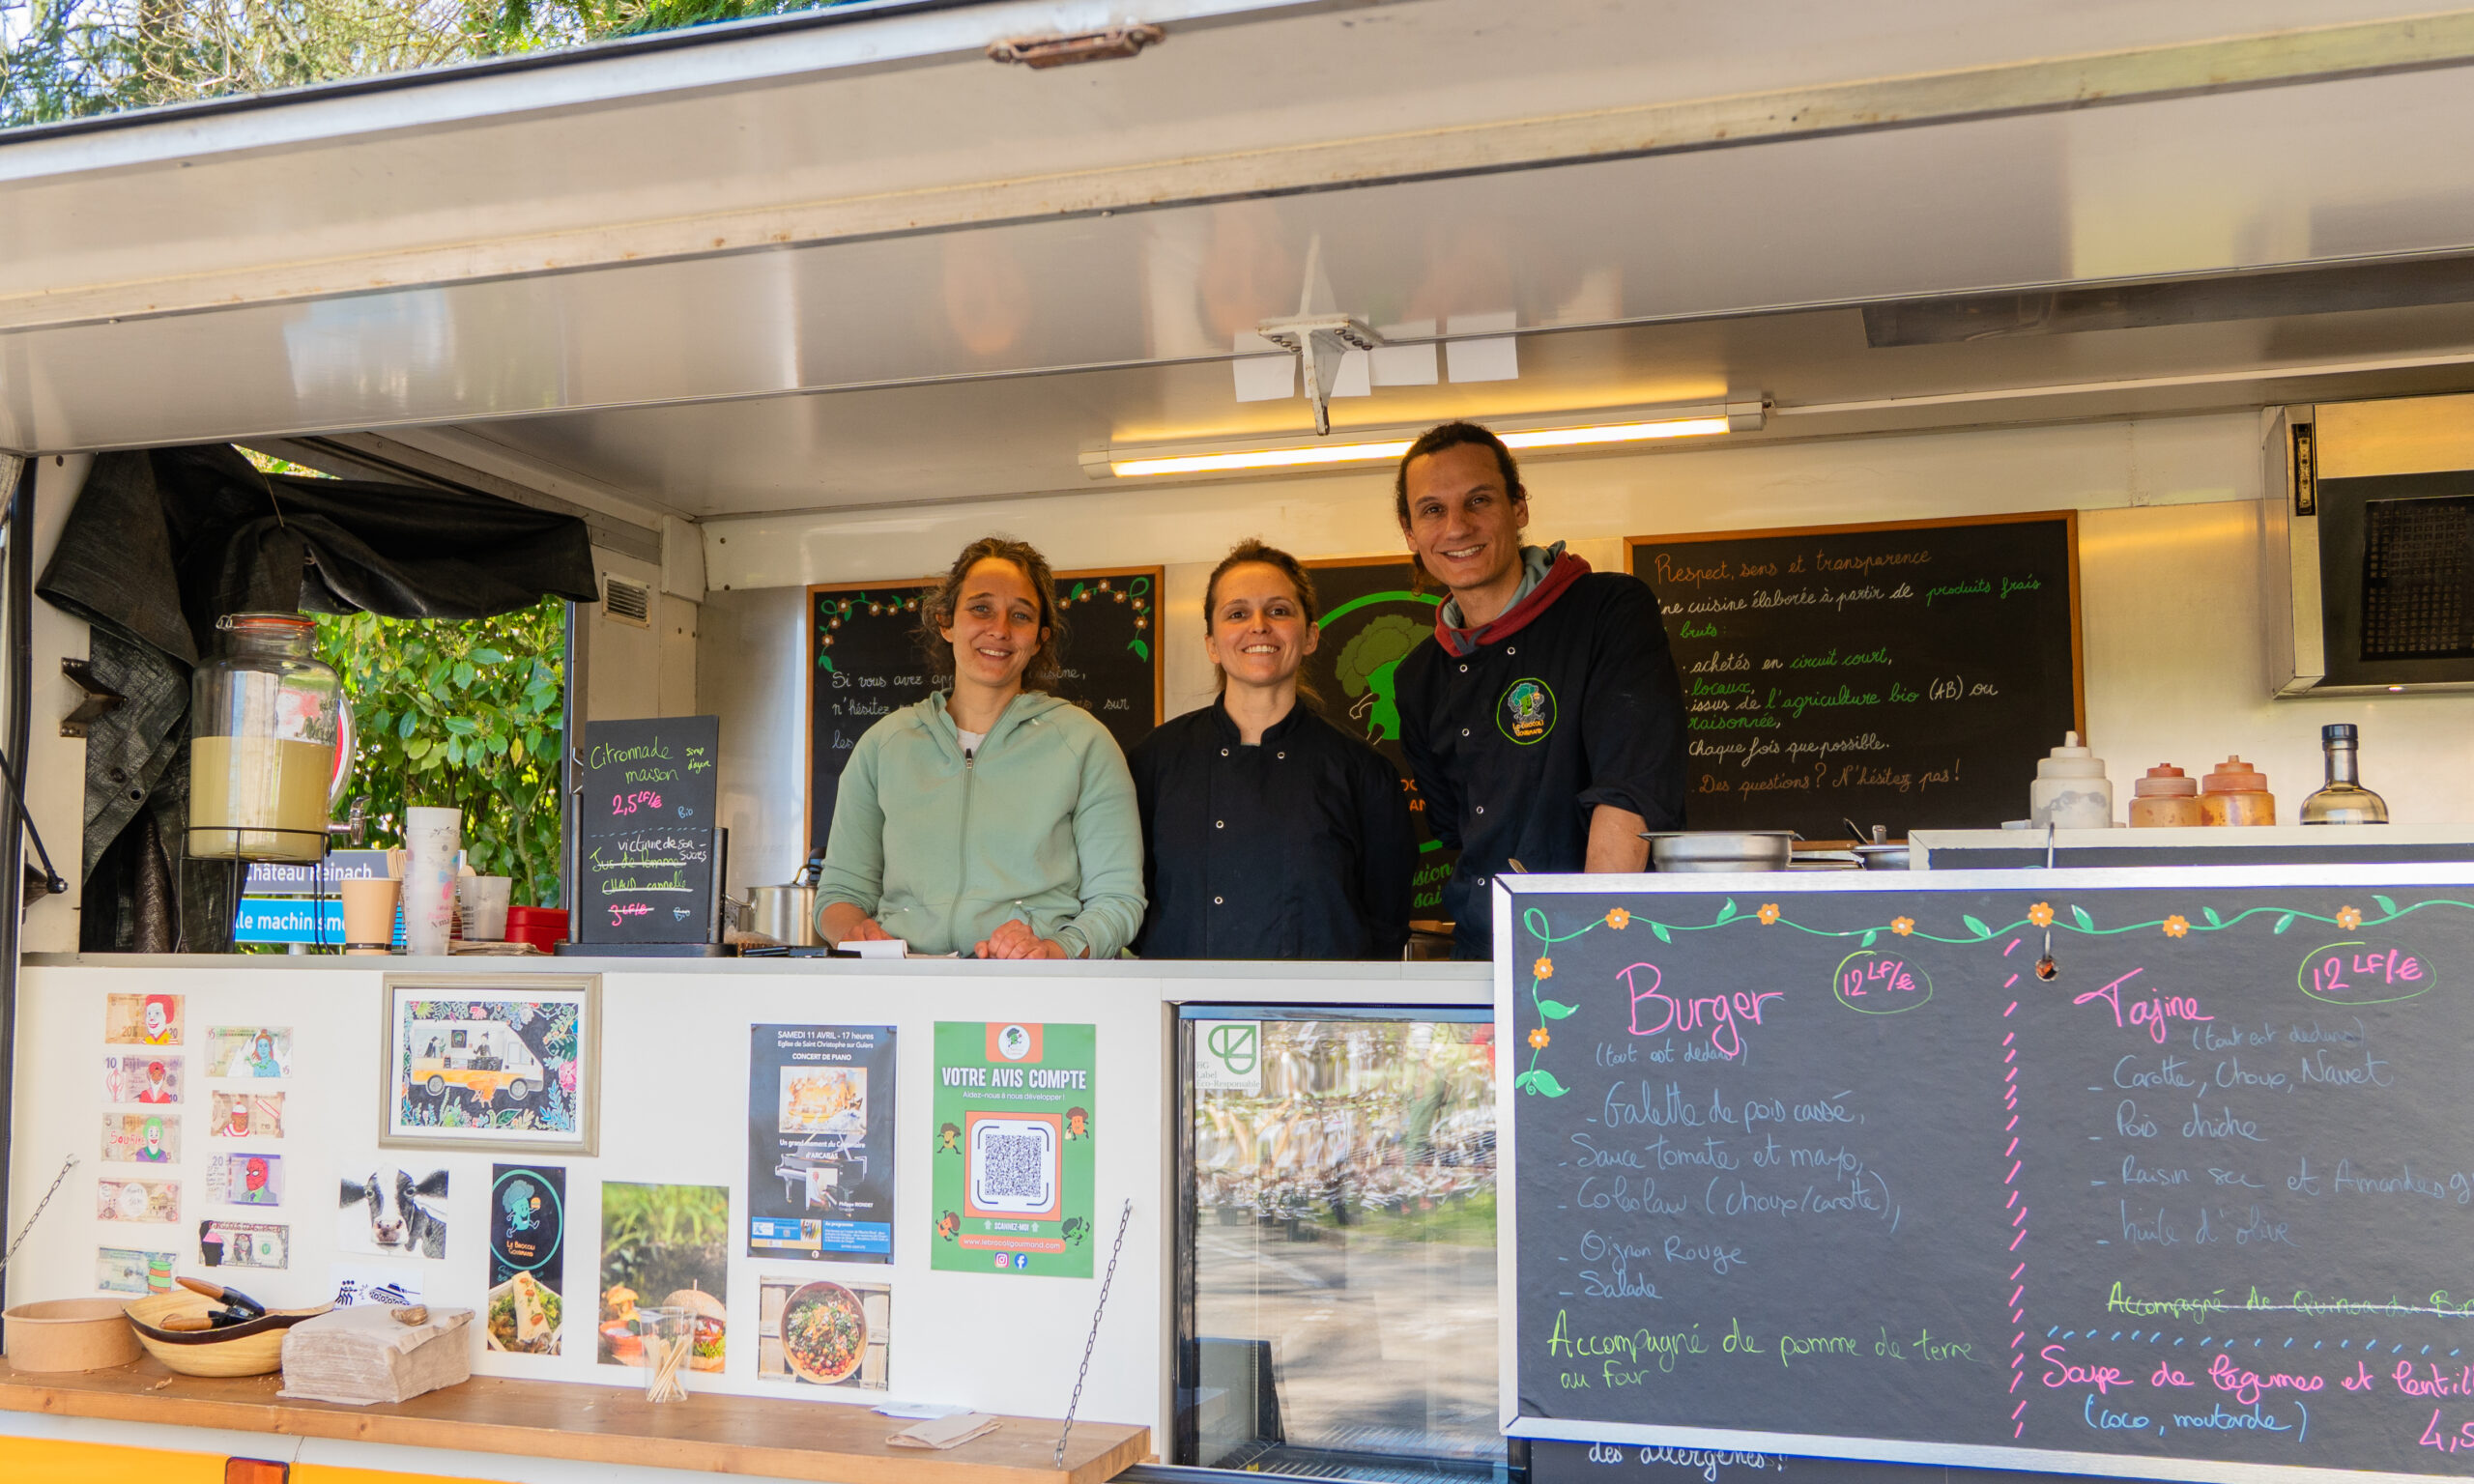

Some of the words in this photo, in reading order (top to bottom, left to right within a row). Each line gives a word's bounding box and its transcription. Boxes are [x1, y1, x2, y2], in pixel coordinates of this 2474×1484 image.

[1654, 547, 1735, 589] Respect,
[1740, 562, 1778, 579] sens
[1788, 557, 1806, 575] et
[1816, 547, 1933, 580] transparence
[1687, 595, 1747, 614] cuisine
[1750, 588, 1817, 610] élaborée
[1820, 587, 1834, 603] à
[1835, 583, 1885, 612] partir
[1888, 582, 1913, 600] de
[1926, 578, 1992, 607] produits
[1999, 574, 2042, 600] frais
[831, 671, 851, 689] Si
[857, 675, 887, 688] vous
[893, 674, 923, 686] avez
[1690, 652, 1751, 685] achetés
[1761, 659, 1783, 671] en
[1790, 648, 1838, 670] circuit
[1841, 647, 1892, 669] court,
[831, 696, 890, 716] n'hésitez
[1103, 697, 1131, 711] sur
[1691, 695, 1730, 713] issus
[1739, 692, 1761, 711] de
[1765, 686, 1881, 719] l'agriculture
[1888, 681, 1920, 704] bio
[1928, 675, 1965, 701] (AB)
[1969, 681, 1999, 697] ou
[590, 735, 674, 770] Citronnade
[831, 728, 854, 750] les
[1741, 736, 1781, 768] fois
[1786, 741, 1820, 763] que
[1819, 732, 1891, 759] possible.
[624, 767, 679, 785] maison
[1698, 773, 1731, 793] Des
[662, 836, 677, 849] de
[1616, 961, 1785, 1057] Burger
[2072, 966, 2214, 1044] Tajine
[777, 1030, 806, 1040] SAMEDI
[807, 1031, 816, 1040] 11
[817, 1031, 836, 1040] AVRIL
[842, 1031, 850, 1040] 17
[850, 1031, 875, 1041] heures
[1596, 1039, 1637, 1066] (tout
[1650, 1038, 1674, 1064] est
[791, 1052, 821, 1061] CONCERT
[831, 1053, 852, 1062] PIANO
[2302, 1049, 2395, 1088] Navet
[941, 1066, 987, 1088] VOTRE
[992, 1067, 1024, 1089] AVIS
[1028, 1069, 1087, 1091] COMPTE
[963, 1091, 1001, 1099] Aidez-nous
[1024, 1092, 1061, 1102] développer
[1603, 1081, 1706, 1127] Galette
[1709, 1088, 1738, 1124] de
[1744, 1097, 1786, 1133] pois
[2116, 1099, 2158, 1138] Pois
[2182, 1101, 2268, 1142] chiche
[1570, 1132, 1646, 1168] Sauce
[1753, 1133, 1782, 1168] et
[2121, 1155, 2191, 1186] Raisin
[2287, 1156, 2319, 1195] et
[993, 1221, 1030, 1232] SCANNEZ-MOI
[2120, 1199, 2180, 1246] huile
[963, 1238, 1061, 1250] www.lebrocoligourmand.com
[1580, 1229, 1652, 1274] Oignon
[1664, 1234, 1747, 1274] Rouge
[1578, 1270, 1663, 1299] Salade
[1546, 1308, 1710, 1373] Accompagné
[1722, 1316, 1766, 1355] de
[1779, 1332, 1864, 1368] pomme
[1875, 1326, 1907, 1361] de
[1913, 1327, 1981, 1362] terre
[1560, 1372, 1591, 1391] au
[2040, 1344, 2135, 1395] Soupe
[2150, 1360, 2195, 1388] de
[2207, 1353, 2324, 1405] légumes
[2340, 1360, 2373, 1392] et
[1588, 1441, 1624, 1464] des
